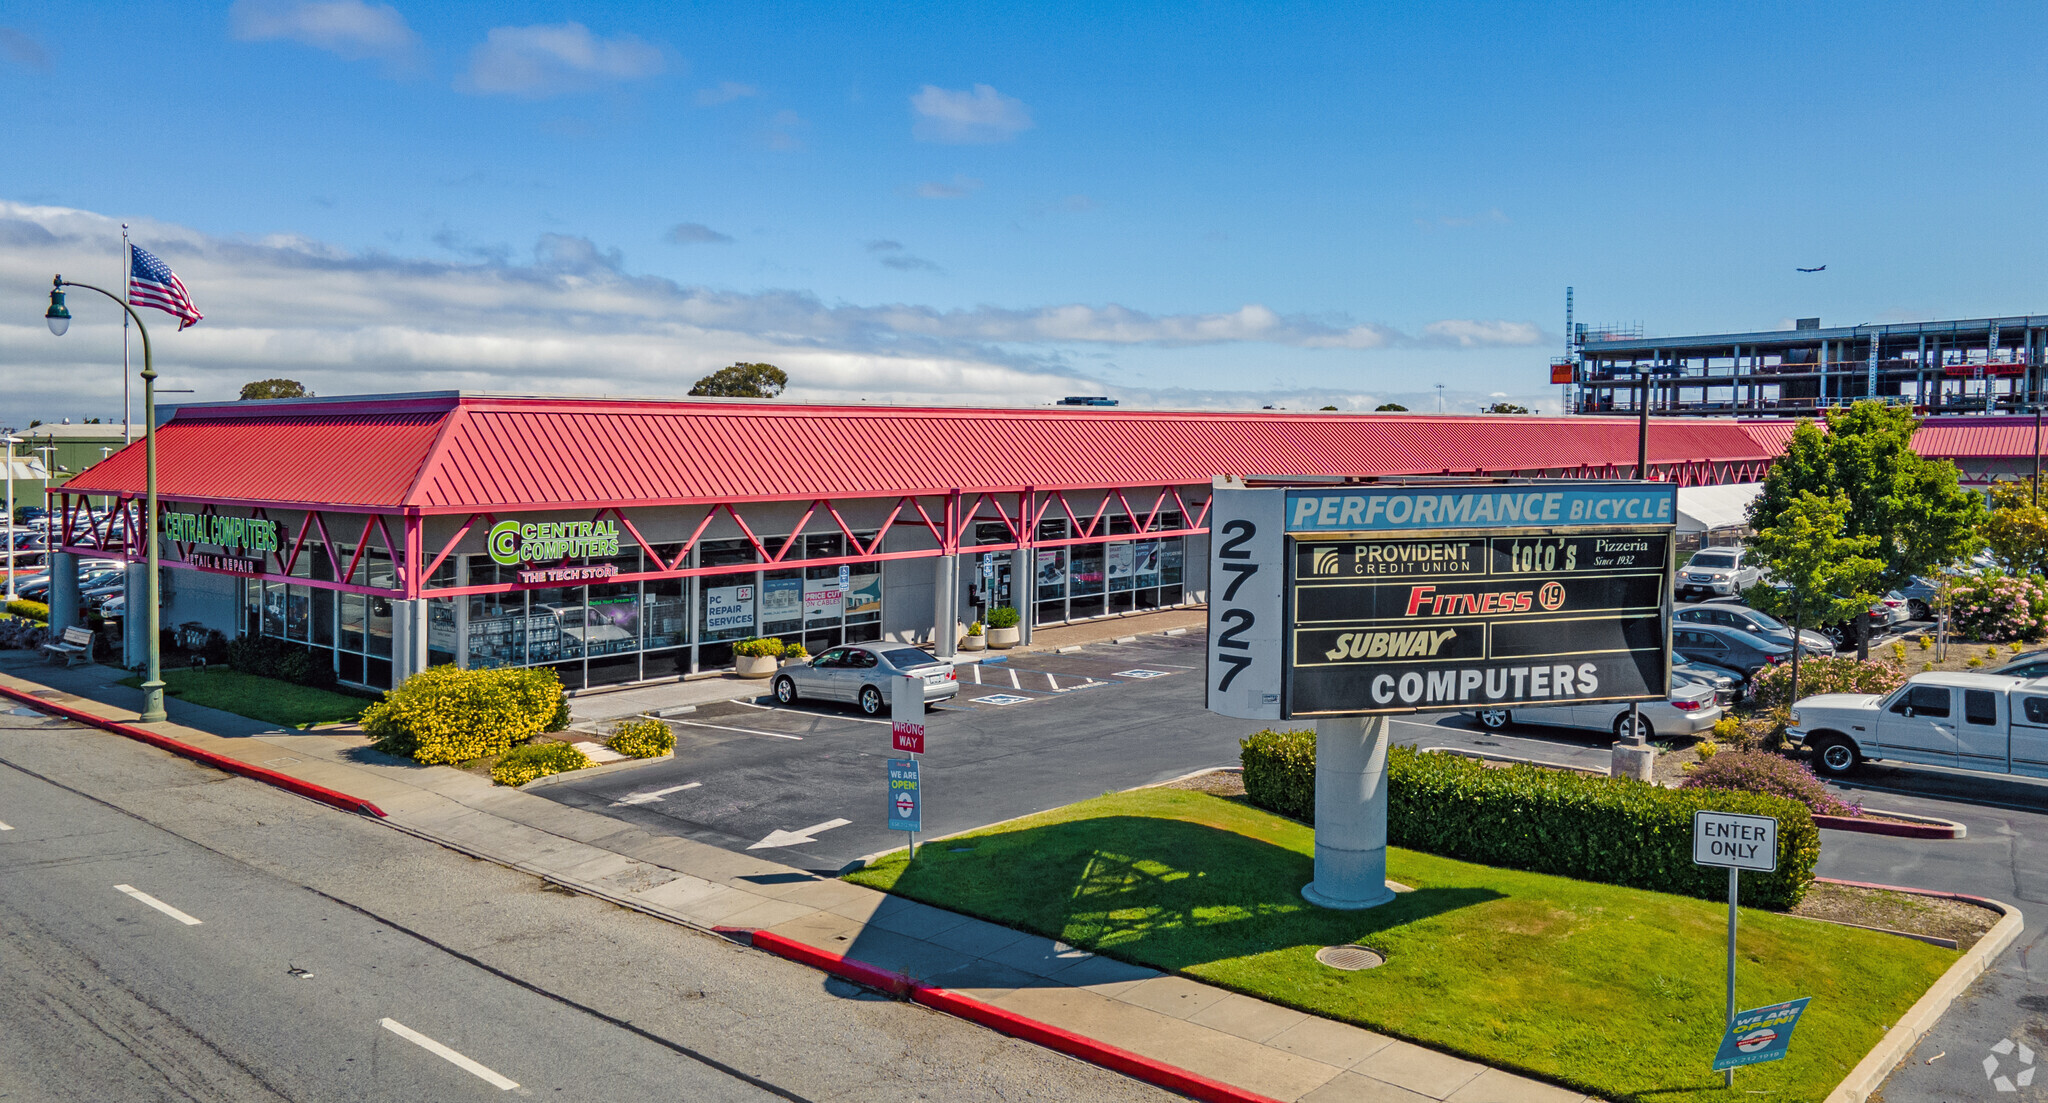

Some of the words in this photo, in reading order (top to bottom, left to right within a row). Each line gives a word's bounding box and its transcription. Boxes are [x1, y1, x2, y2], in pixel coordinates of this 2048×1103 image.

[1292, 493, 1563, 526] PERFORMANCE
[1569, 498, 1671, 520] BICYCLE
[165, 512, 209, 544] CENTRAL
[211, 515, 278, 552] COMPUTERS
[521, 520, 619, 539] CENTRAL
[520, 538, 619, 561] COMPUTERS
[1355, 543, 1470, 563] PROVIDENT
[1595, 538, 1648, 553] Pizzeria
[214, 556, 220, 569] &
[223, 558, 254, 573] REPAIR
[1355, 562, 1414, 574] CREDIT
[1422, 561, 1470, 572] UNION
[1593, 556, 1614, 566] Since
[1616, 555, 1635, 565] 1932
[523, 570, 546, 583] THE
[548, 569, 579, 581] TECH
[582, 567, 619, 580] STORE
[709, 595, 722, 605] PC
[805, 592, 825, 600] PRICE
[827, 590, 841, 599] CUT
[816, 599, 840, 607] CABLES
[1542, 584, 1563, 607] 19
[709, 604, 742, 616] REPAIR
[708, 614, 753, 627] SERVICES
[1326, 629, 1457, 661] SUBWAY
[1372, 663, 1599, 704] COMPUTERS
[893, 721, 923, 736] WRONG
[899, 735, 918, 748] WAY
[903, 771, 917, 780] ARE
[891, 780, 918, 790] OPEN!
[1705, 822, 1766, 841] ENTER
[1711, 841, 1758, 859] ONLY
[1733, 1015, 1795, 1033] OPEN!
[1737, 1015, 1762, 1025] WE
[1766, 1007, 1800, 1019] ARE
